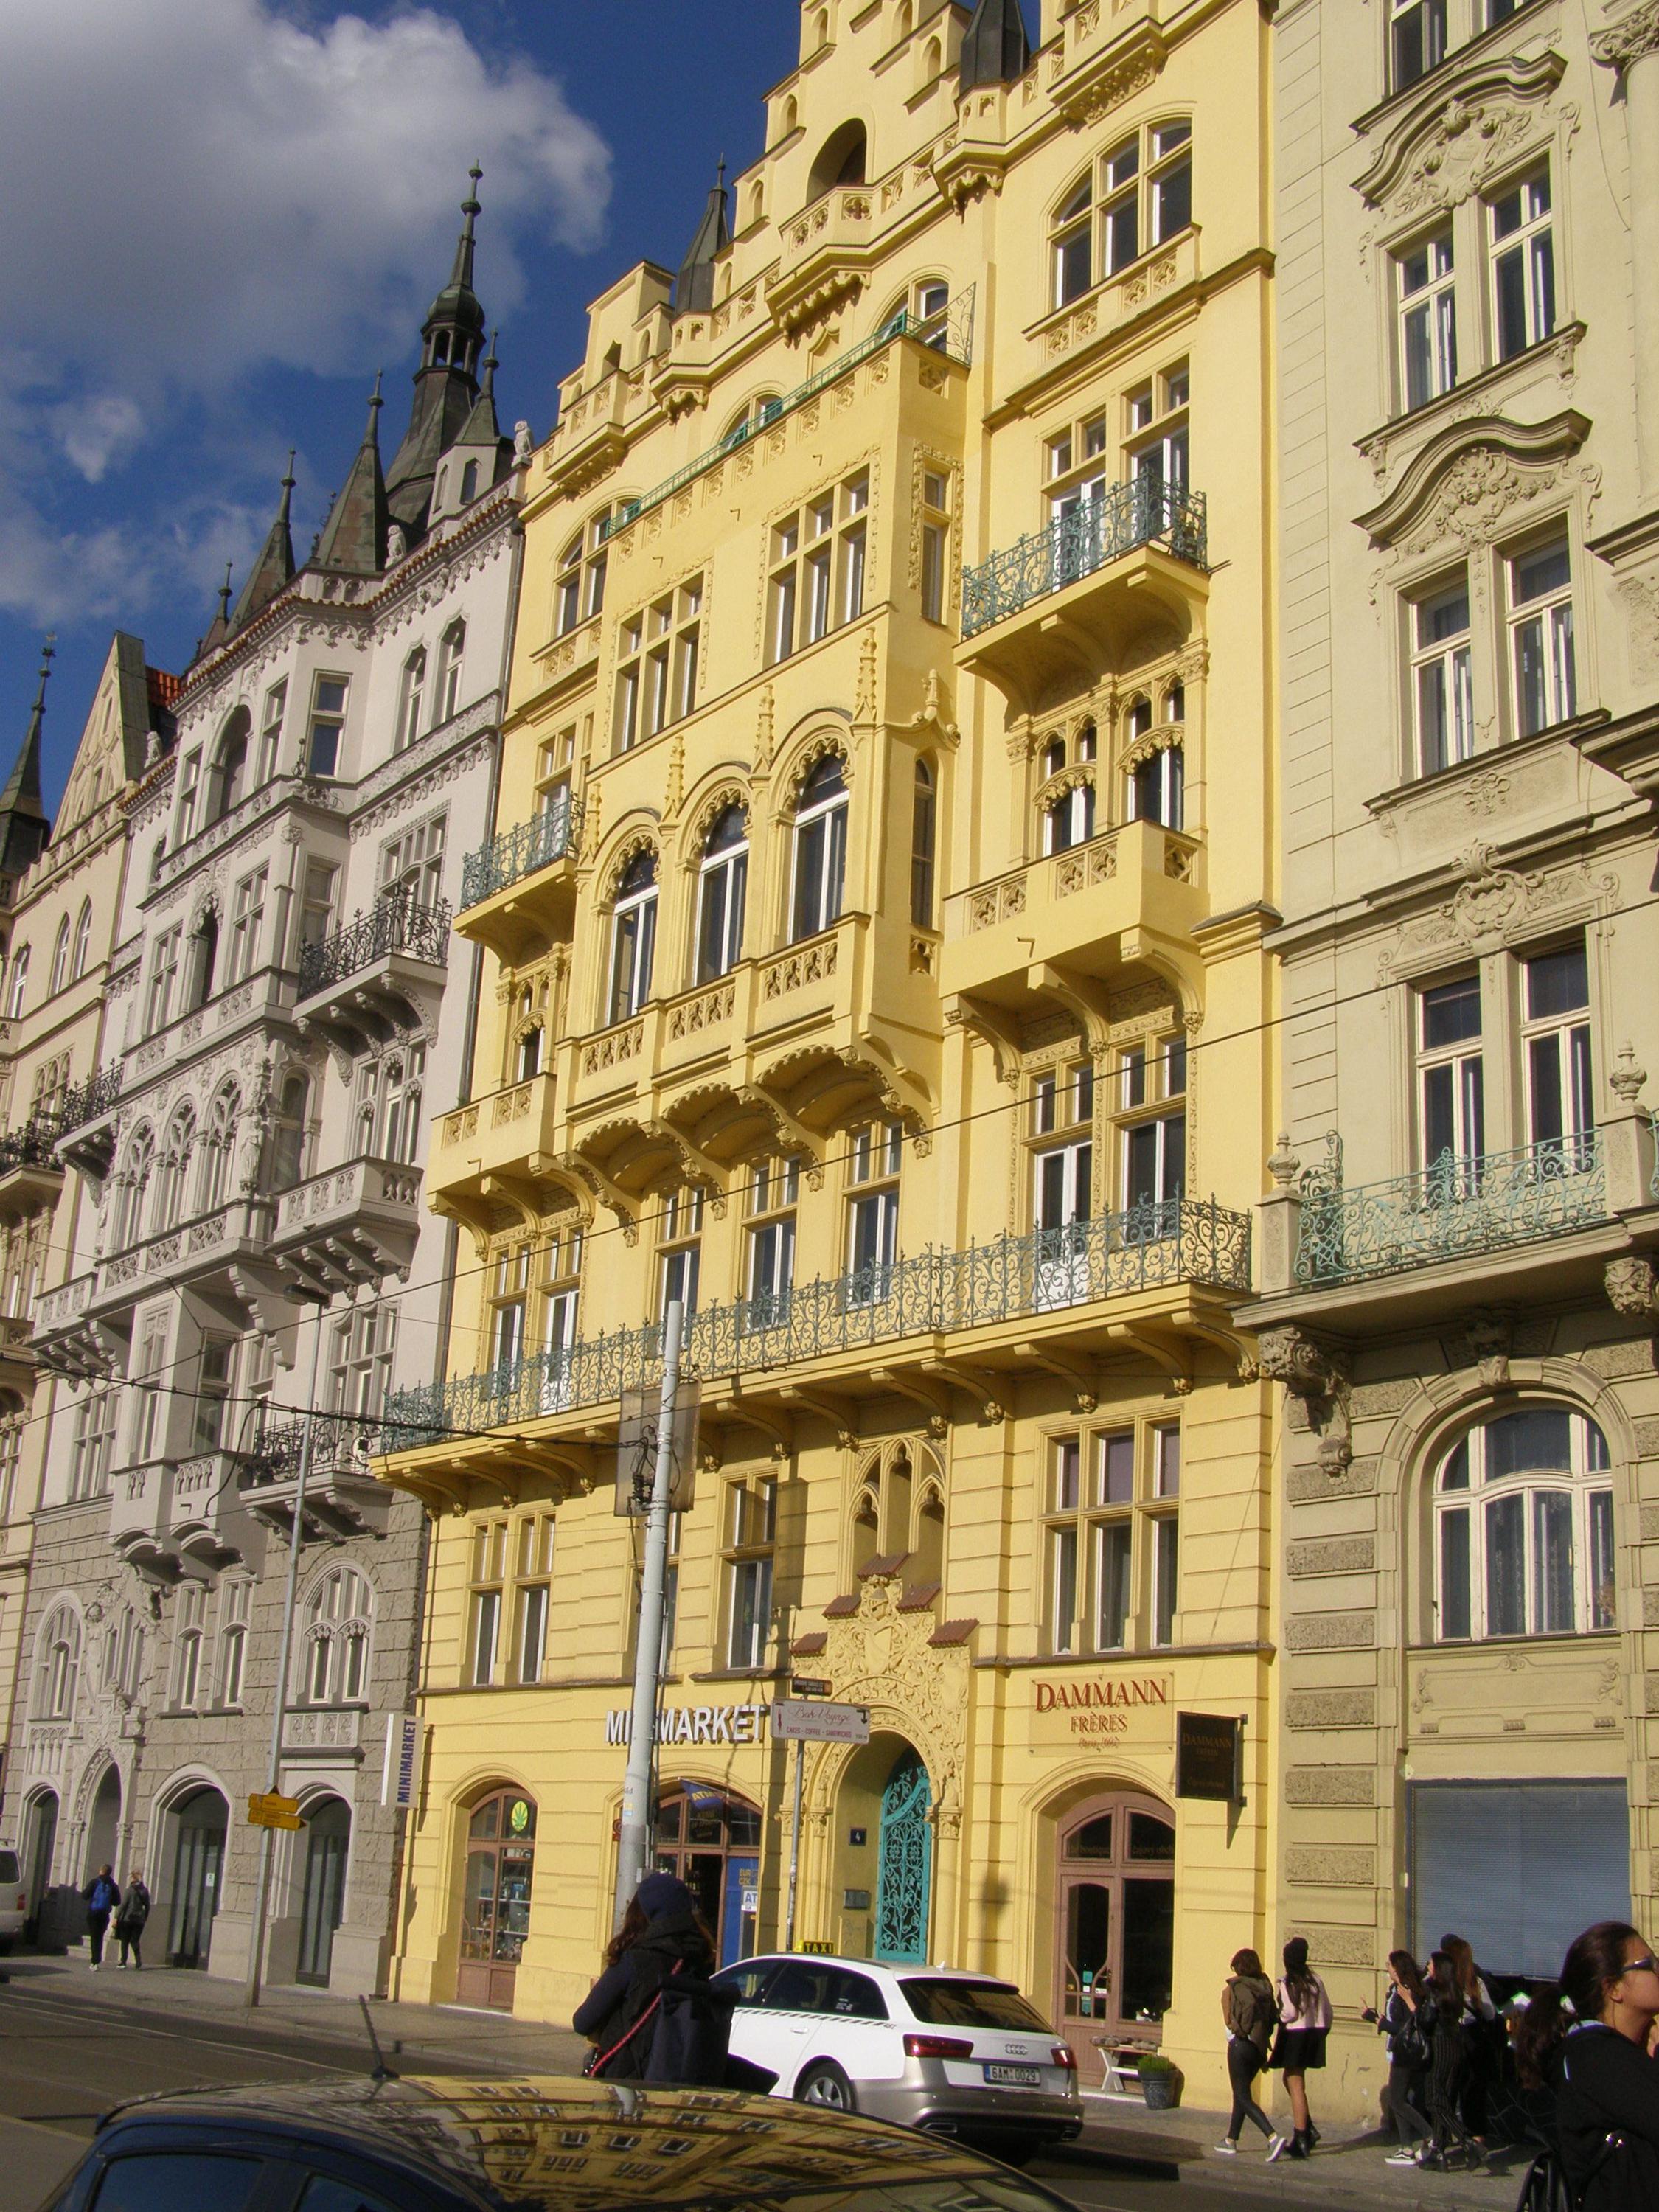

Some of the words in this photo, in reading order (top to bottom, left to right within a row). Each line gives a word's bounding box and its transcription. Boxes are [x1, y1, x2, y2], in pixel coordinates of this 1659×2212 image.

[1036, 1678, 1167, 1713] DAMMANN
[605, 1705, 762, 1743] MIMARKET
[1071, 1711, 1128, 1733] FRÈRES
[805, 1728, 821, 1736] COFFEE
[397, 1719, 417, 1803] MINIMARKET
[745, 1892, 758, 1903] AT
[805, 1942, 832, 1953] TAXI
[992, 2067, 1009, 2079] 6AM
[1015, 2069, 1036, 2082] 0029
